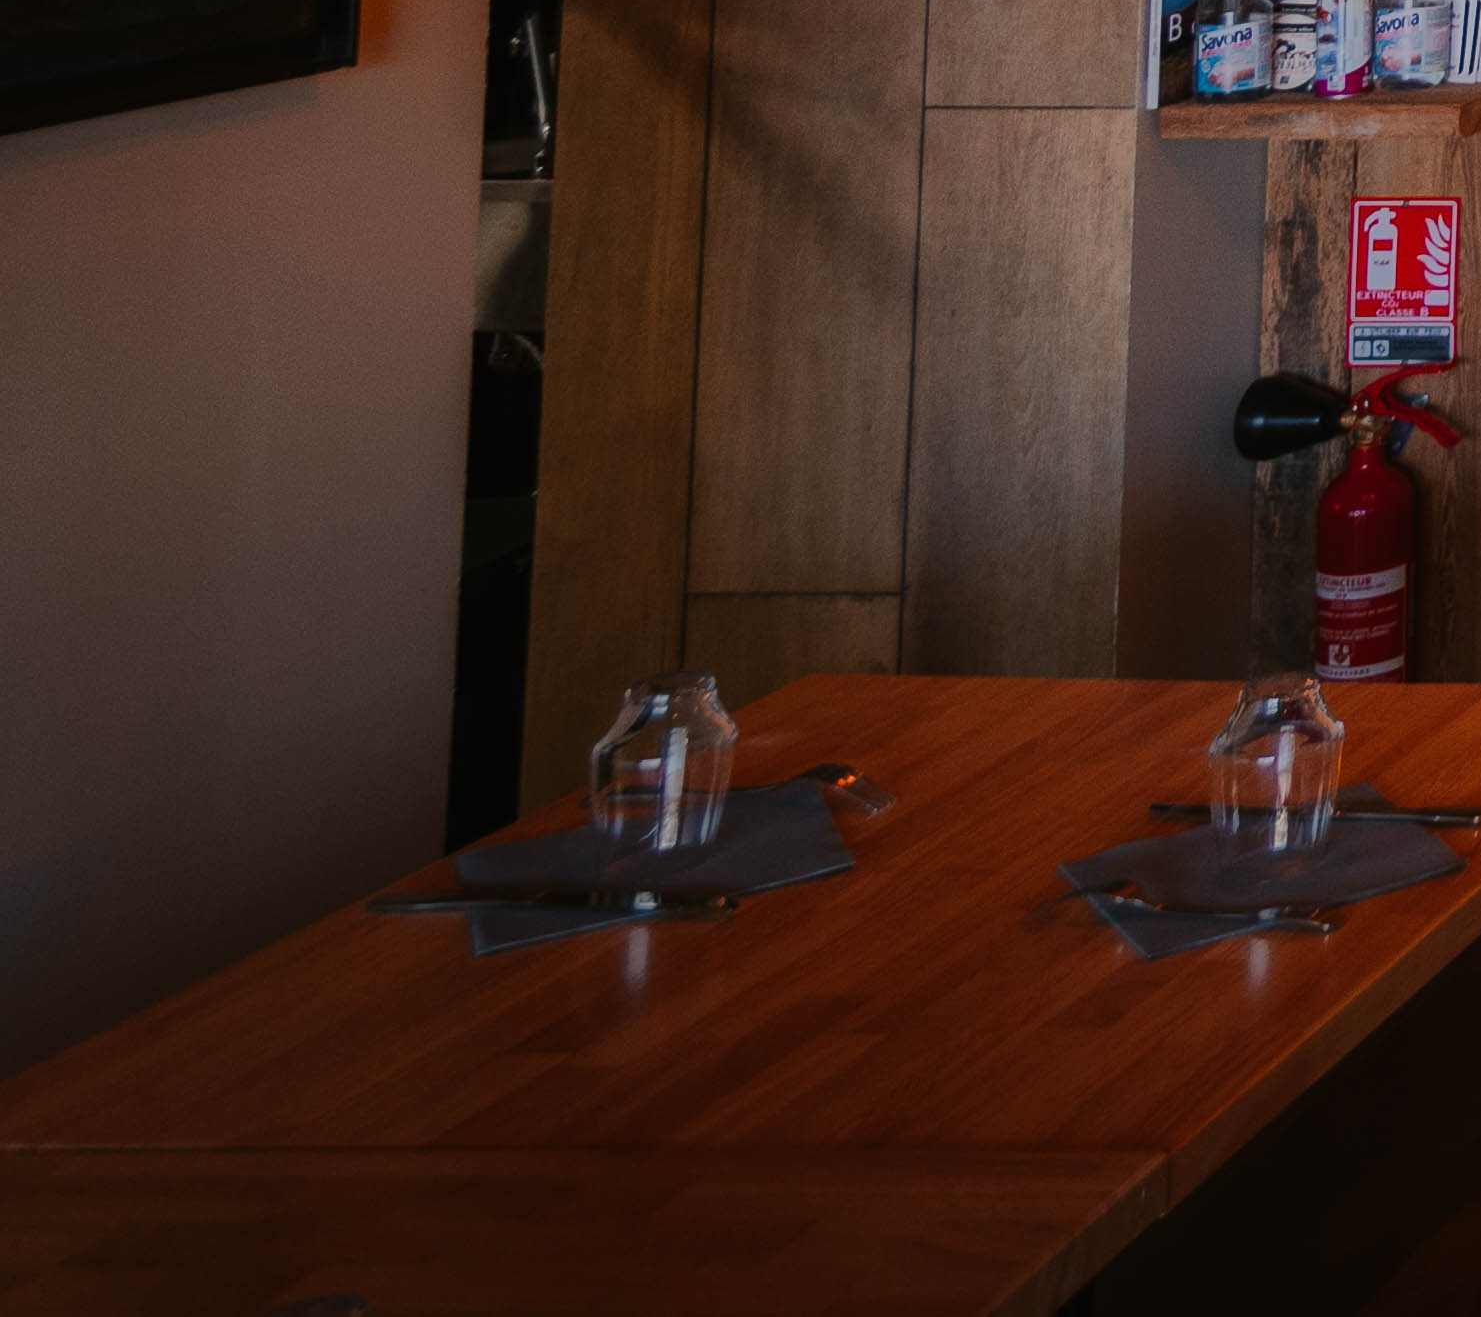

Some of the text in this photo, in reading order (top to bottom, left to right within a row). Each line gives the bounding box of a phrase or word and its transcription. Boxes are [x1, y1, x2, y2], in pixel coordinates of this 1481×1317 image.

[1375, 12, 1420, 35] Savoa
[1200, 26, 1253, 52] Savona
[1356, 290, 1425, 301] EXTINCTEUR
